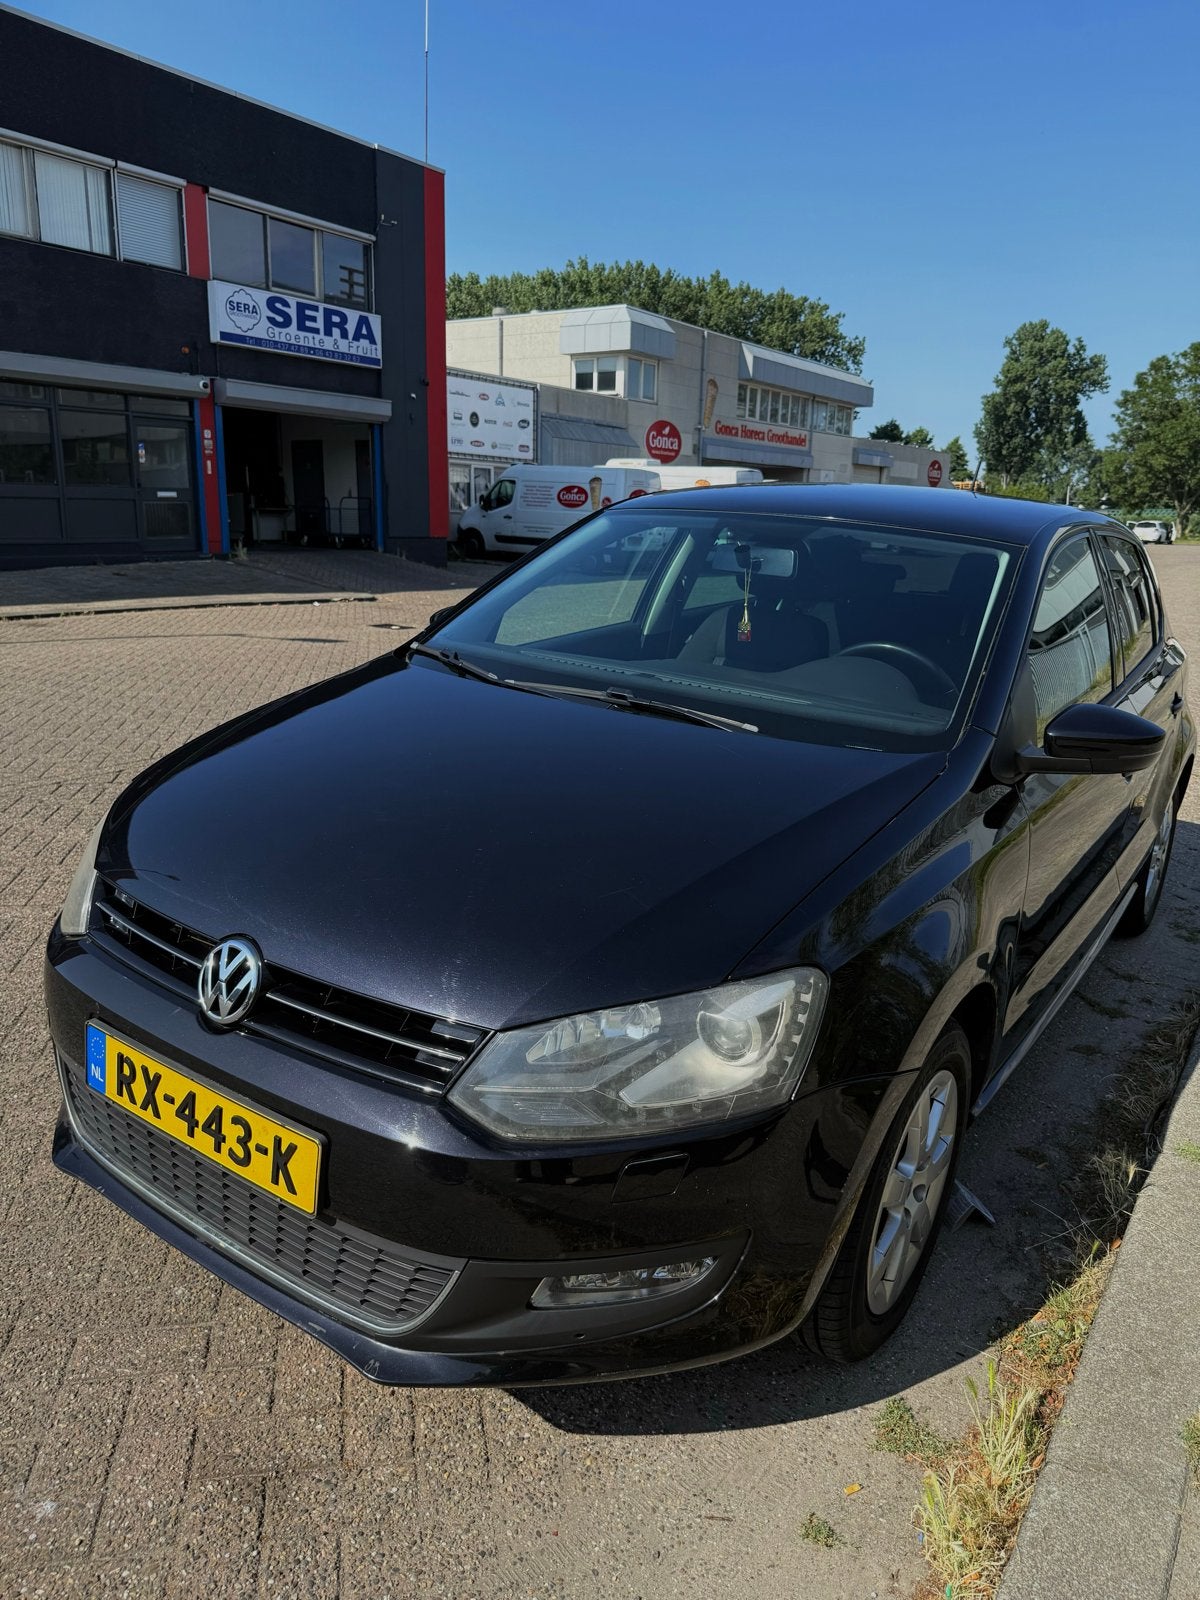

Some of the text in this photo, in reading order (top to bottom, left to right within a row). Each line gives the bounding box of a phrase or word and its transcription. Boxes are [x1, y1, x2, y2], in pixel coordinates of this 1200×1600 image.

[228, 300, 258, 315] SERA
[266, 295, 378, 346] SERA
[266, 326, 379, 357] Groente & Fruit
[649, 431, 679, 450] Gonca
[715, 420, 807, 447] Gonca Horeca Groothandel
[559, 491, 586, 502] Gonca
[90, 1062, 104, 1083] NL
[116, 1051, 298, 1197] RX-443-K
